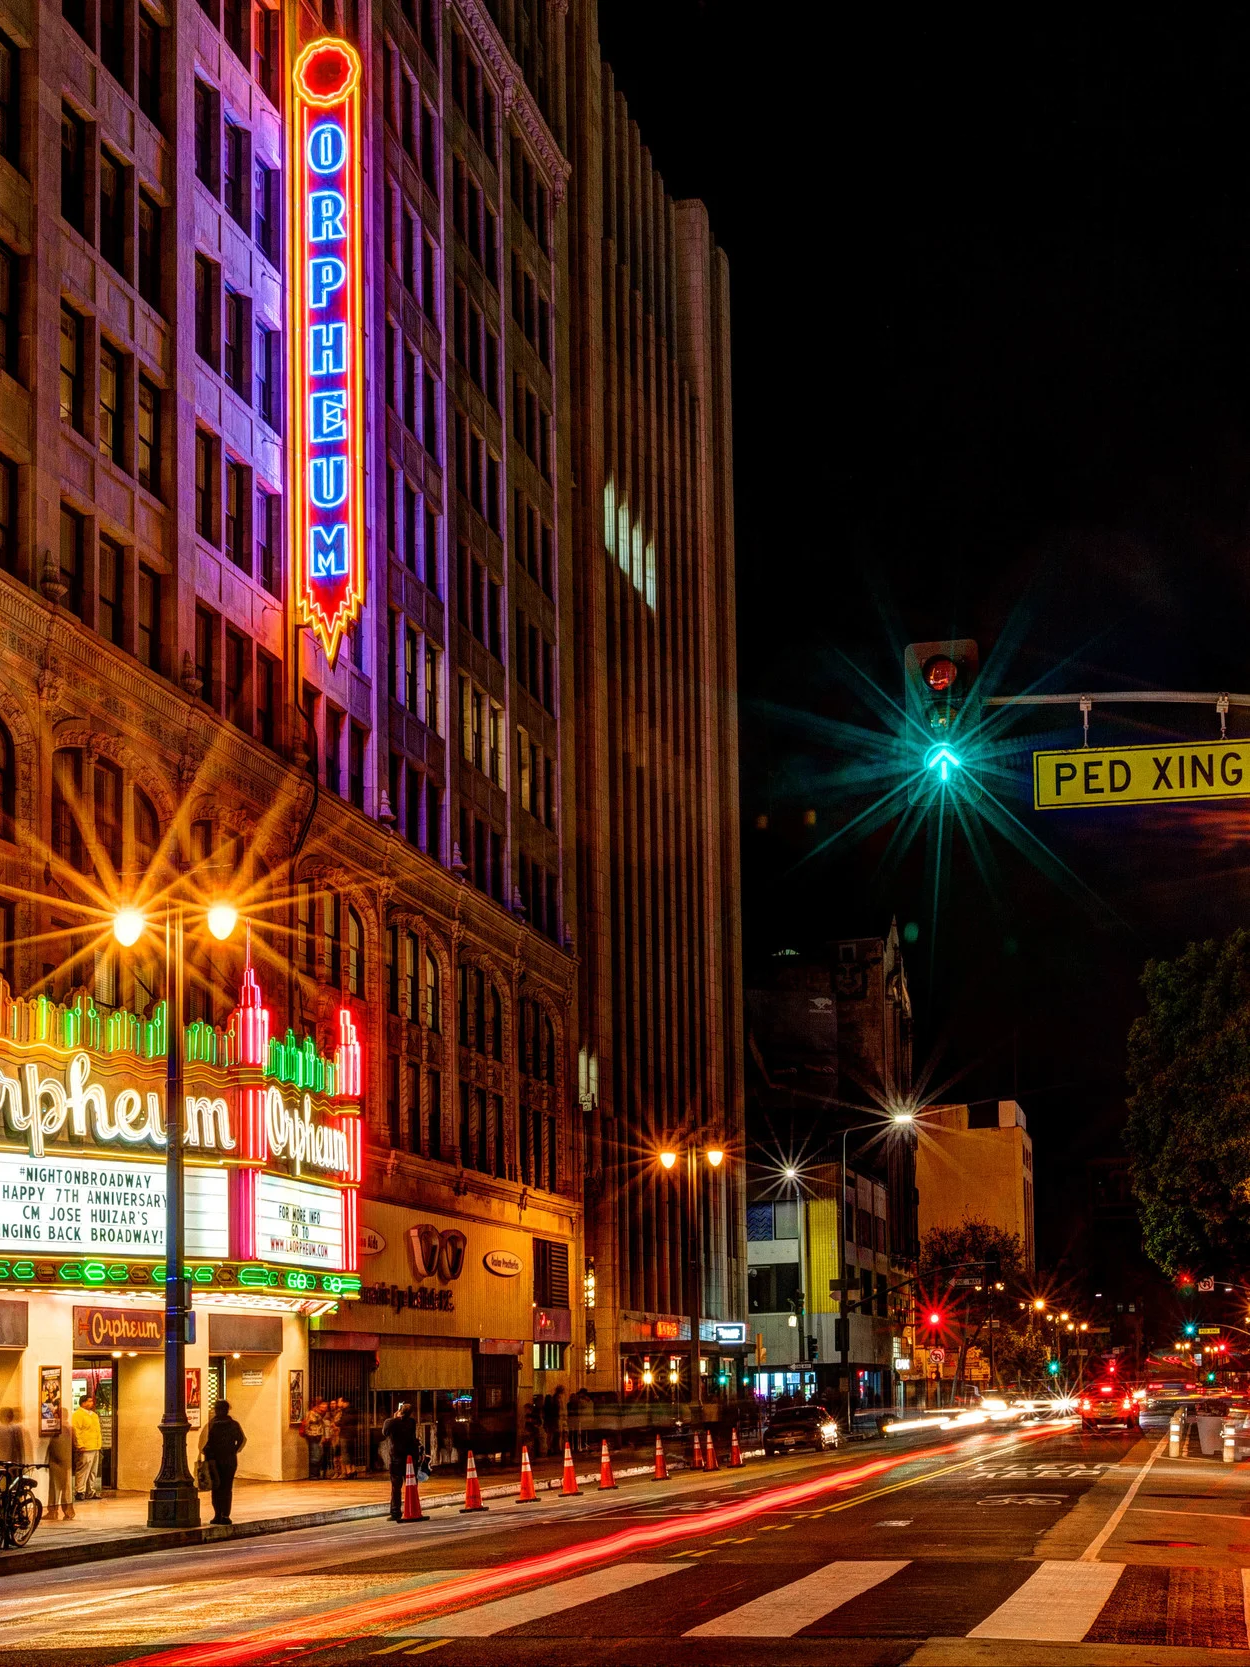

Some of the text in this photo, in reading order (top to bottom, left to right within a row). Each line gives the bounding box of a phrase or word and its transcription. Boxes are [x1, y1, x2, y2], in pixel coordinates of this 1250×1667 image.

[306, 124, 347, 579] ORPHEUM
[1055, 752, 1243, 796] PED XING
[266, 1085, 350, 1177] Orpheum
[19, 1166, 152, 1189] #NIGHTONBROADWAY
[2, 1184, 167, 1208] HAPPY 7TH ANNIVERSARY
[22, 1205, 148, 1226] CM JOSE HUIZAR'S
[278, 1205, 321, 1225] FOR MORE INFO
[48, 1225, 82, 1241] BACK
[90, 1227, 164, 1244] BROADWAY!
[291, 1223, 310, 1239] GO TO
[270, 1237, 329, 1258] WWW.LAORPHEUM.COM
[92, 1312, 161, 1345] Orpheum
[973, 1462, 1121, 1471] CLEAR
